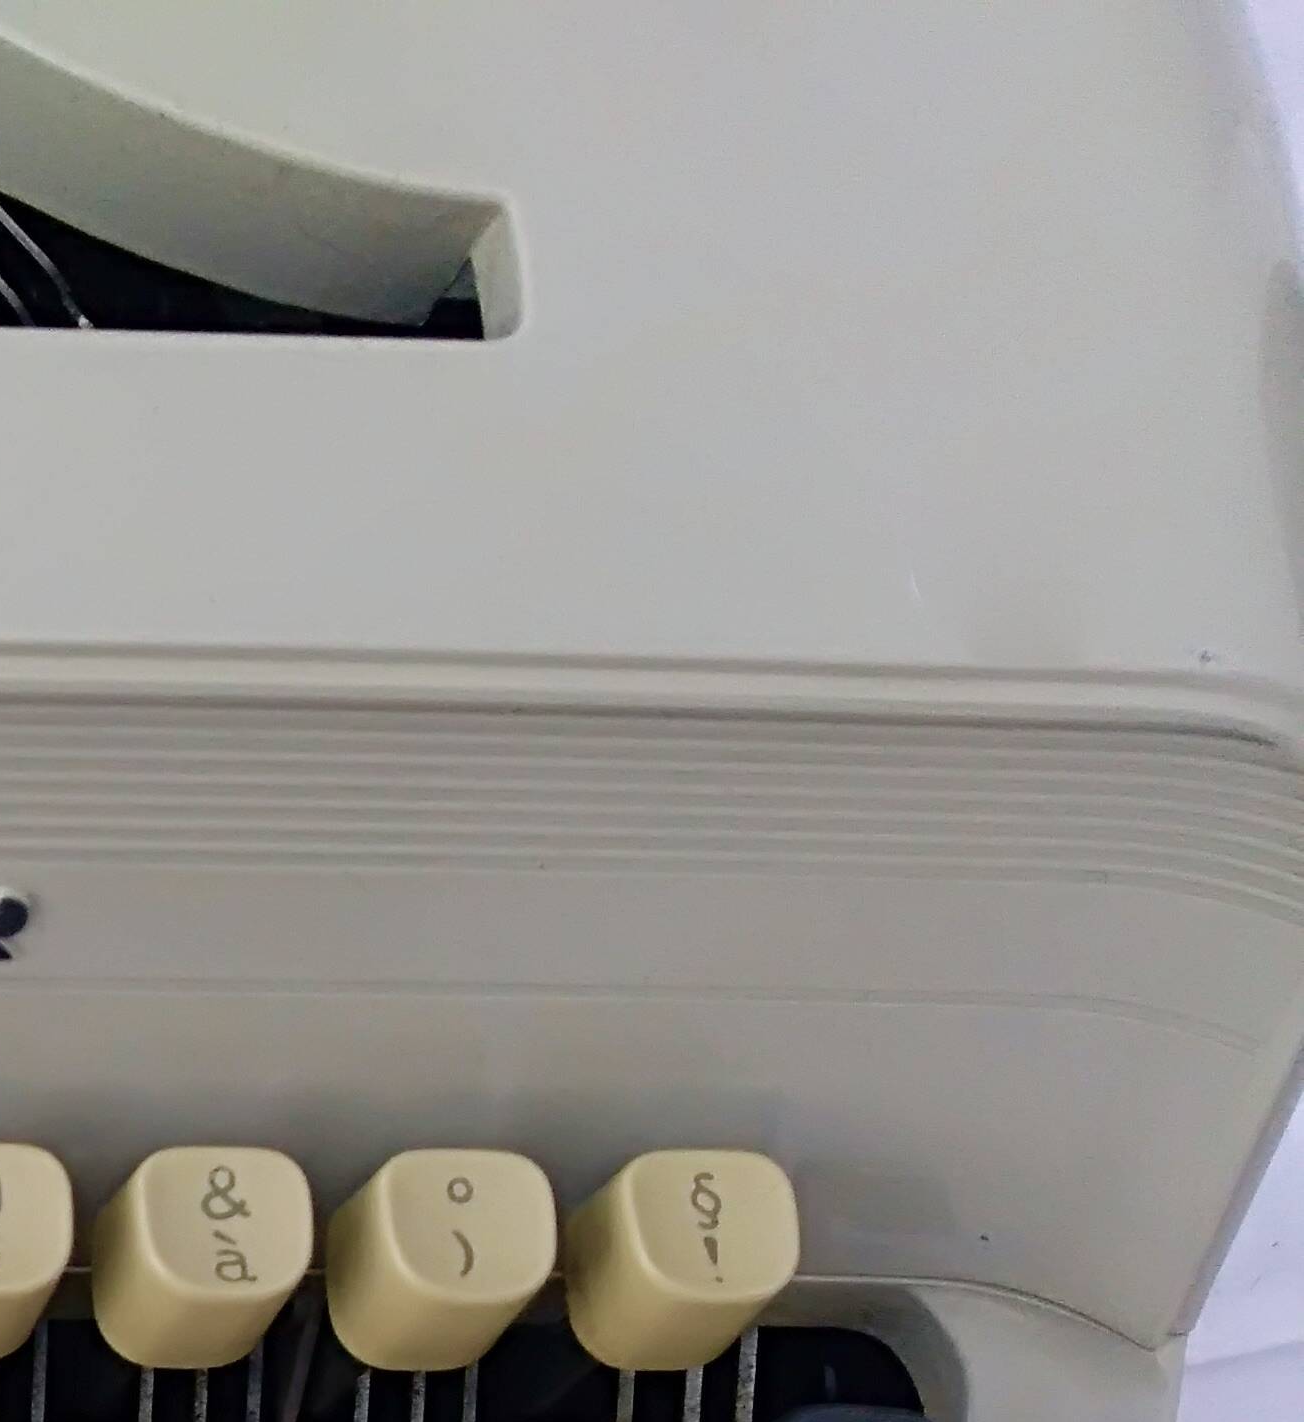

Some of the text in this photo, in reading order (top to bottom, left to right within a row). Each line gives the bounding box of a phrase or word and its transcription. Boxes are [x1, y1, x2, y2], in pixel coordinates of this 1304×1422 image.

[200, 1165, 252, 1221] &
[690, 1171, 723, 1231] §
[212, 1229, 259, 1283] à
[451, 1230, 475, 1278] )
[701, 1234, 724, 1285] !
